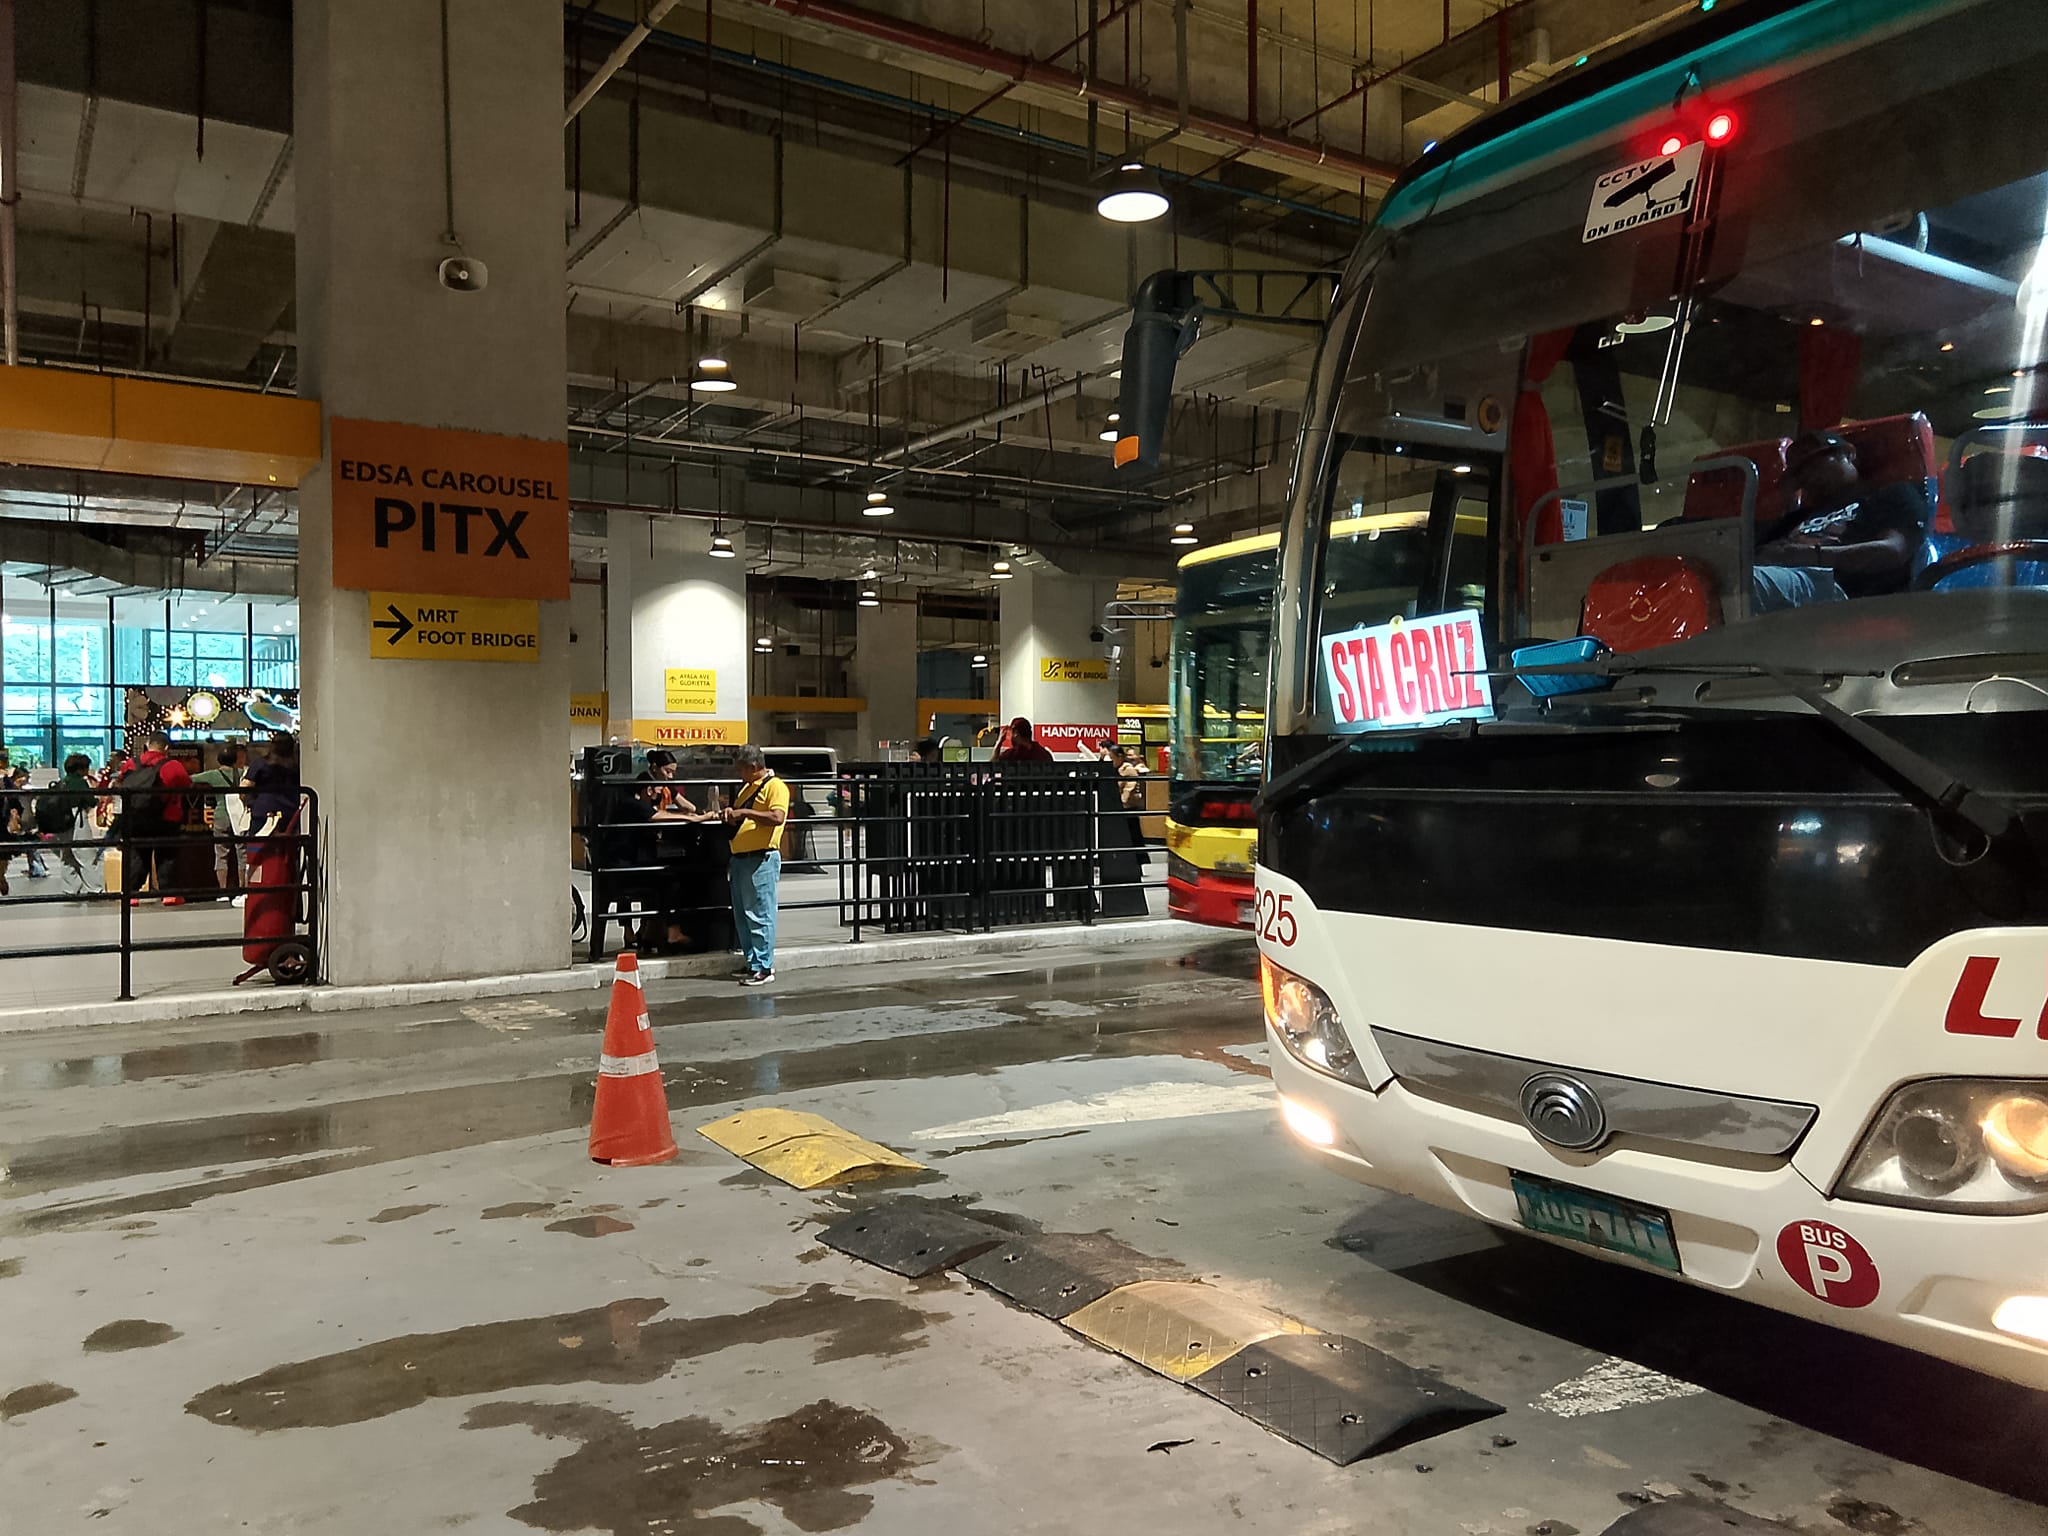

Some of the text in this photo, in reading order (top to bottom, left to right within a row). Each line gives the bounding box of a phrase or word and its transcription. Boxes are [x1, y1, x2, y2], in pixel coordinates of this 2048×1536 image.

[1598, 161, 1653, 189] CCTV
[1586, 203, 1676, 240] ON BOARD
[340, 459, 559, 501] EDSA CAROUSEL
[374, 496, 530, 560] PITX
[417, 608, 459, 624] MRT
[417, 629, 537, 649] FOOT BRIDGE
[1331, 620, 1485, 723] STA CRUZ
[1041, 726, 1111, 738] HANDYMAN
[1943, 954, 2048, 1041] L
[1800, 1224, 1847, 1250] BUS
[1803, 1242, 1852, 1298] P
